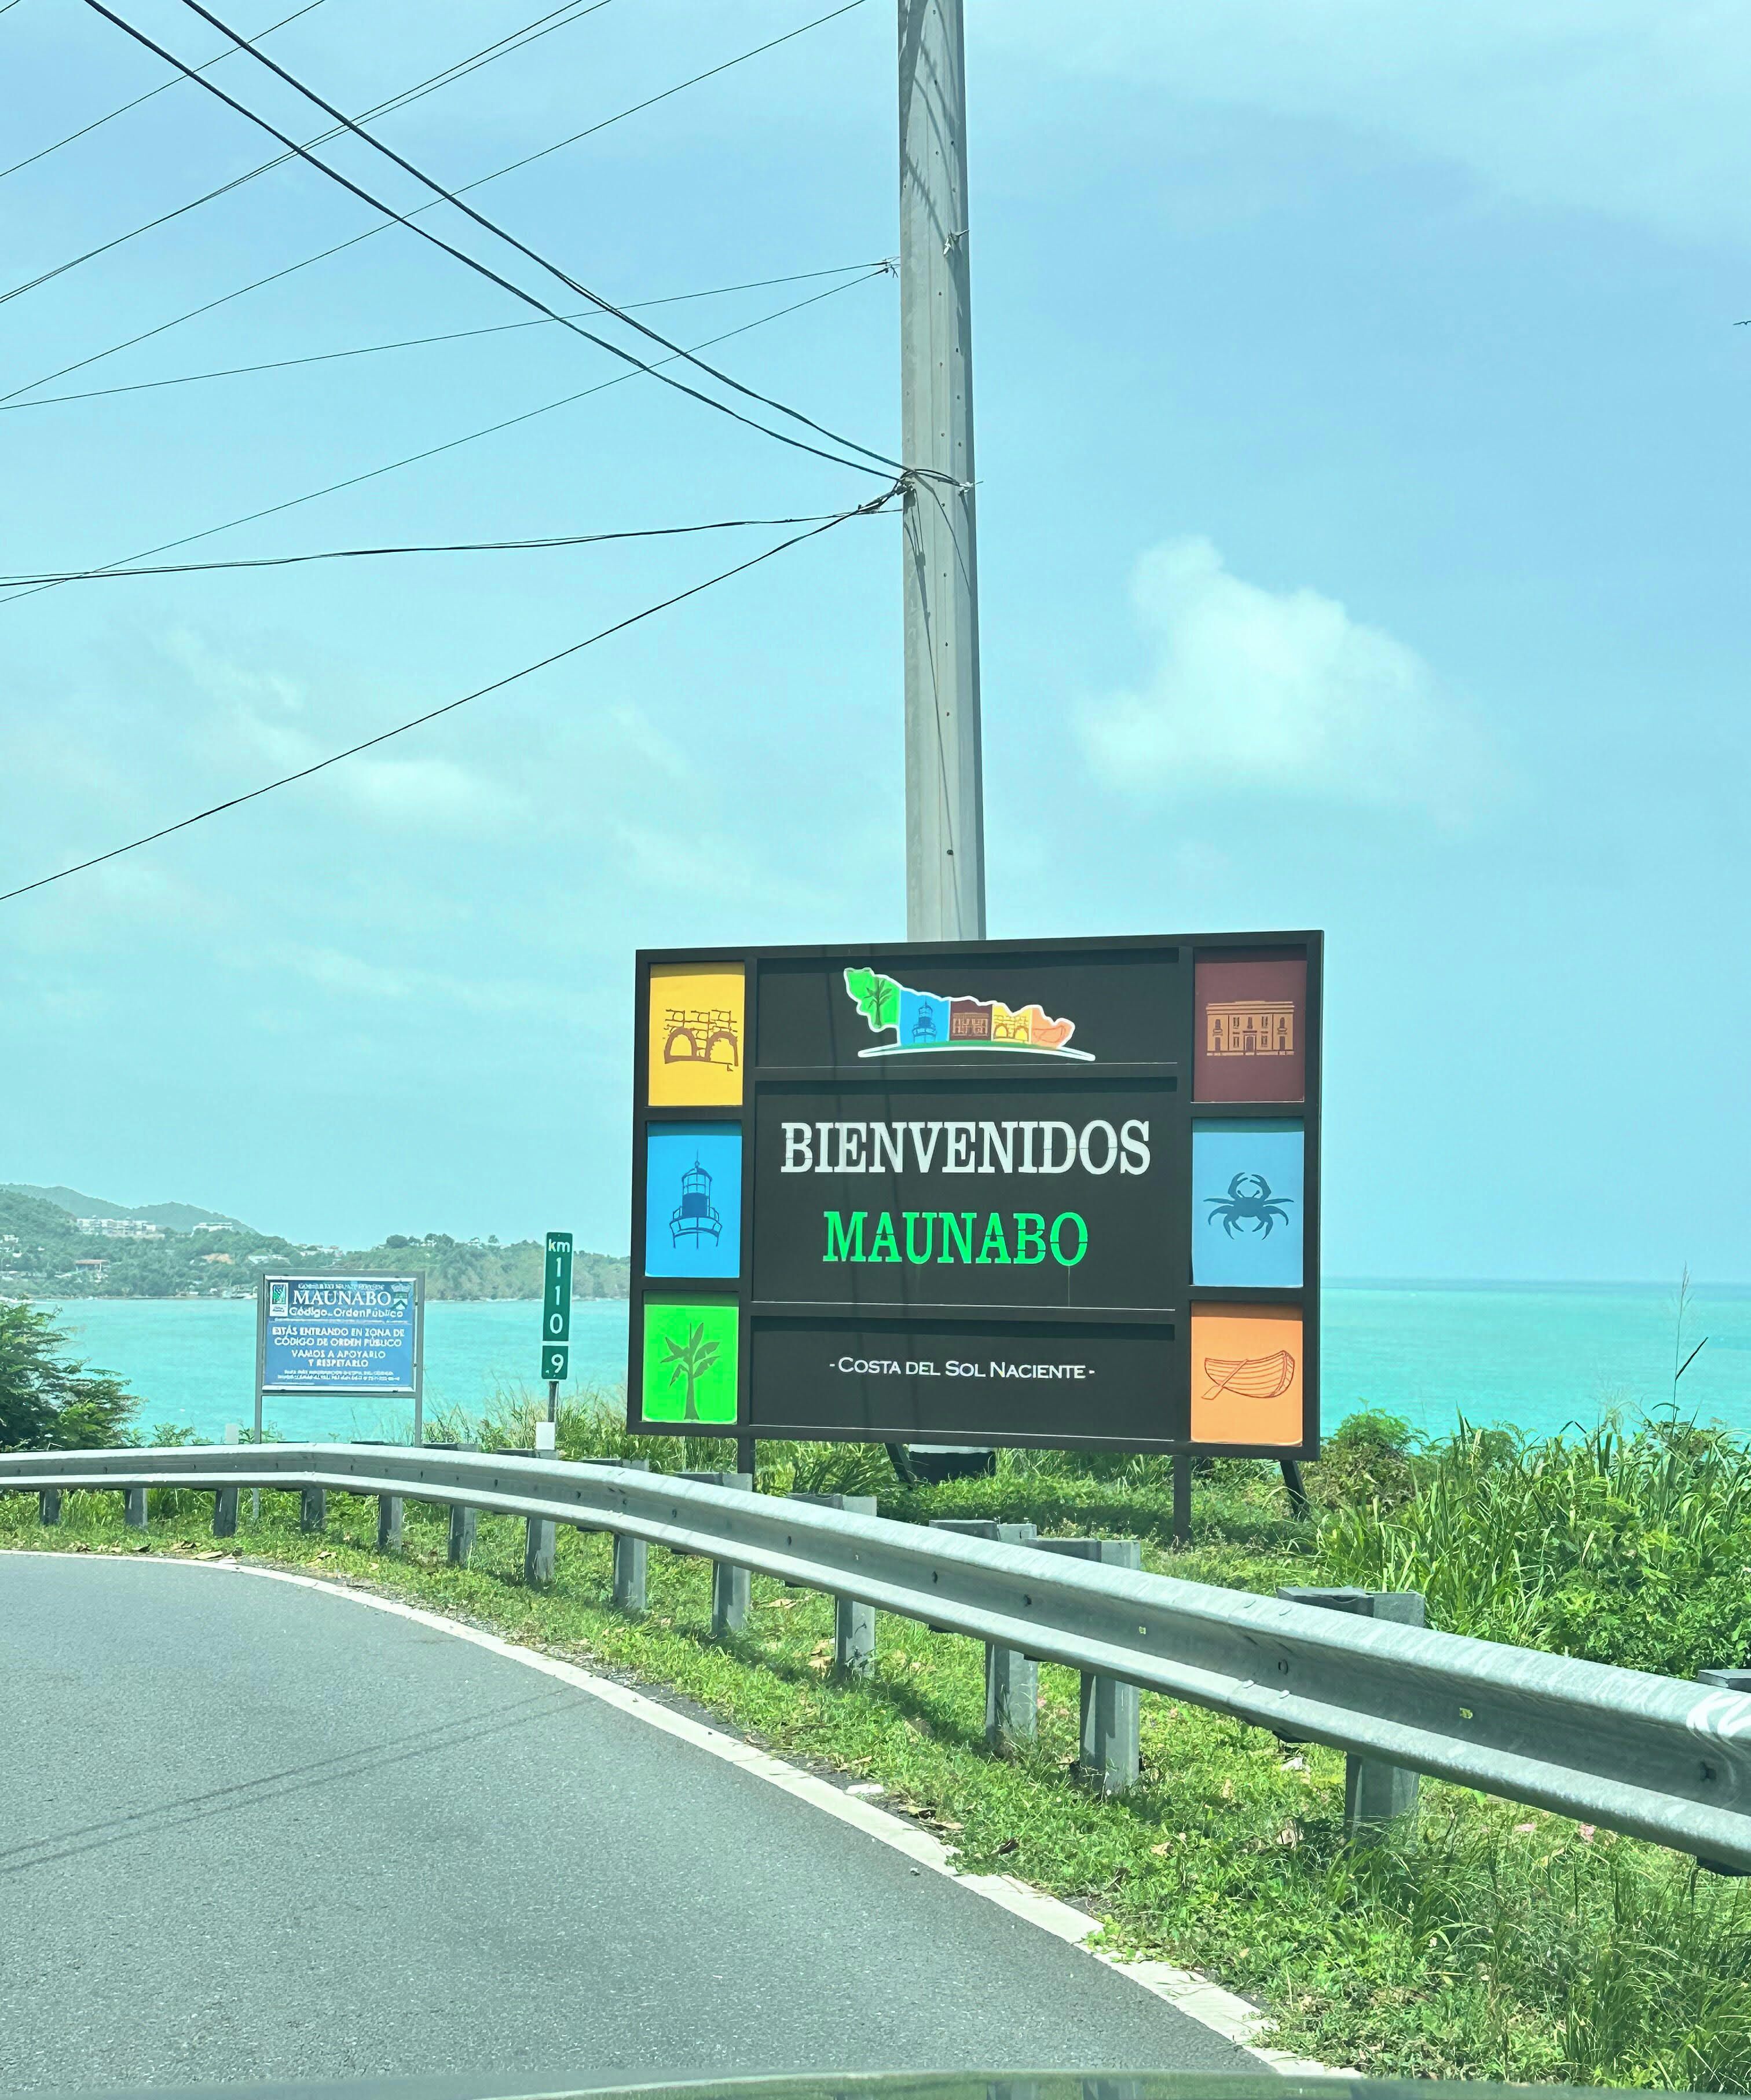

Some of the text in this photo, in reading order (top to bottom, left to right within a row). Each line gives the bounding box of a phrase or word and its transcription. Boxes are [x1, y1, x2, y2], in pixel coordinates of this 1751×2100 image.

[781, 1119, 1151, 1175] BIENVENIDOS
[548, 1238, 570, 1253] km
[823, 1211, 1088, 1267] MAUNABO
[292, 1290, 391, 1306] MAUNABO
[289, 1305, 327, 1318] Código
[272, 1325, 405, 1337] ESTÁS ENTRANDO EN ZONA DE
[274, 1334, 402, 1347] CÓDIGO DE ORDEN PÚBLICO
[291, 1349, 386, 1359] VAMOS A APOYARLO
[308, 1359, 369, 1367] Y RESPETARLO
[551, 1353, 564, 1373] 9
[906, 1362, 941, 1376] DEL
